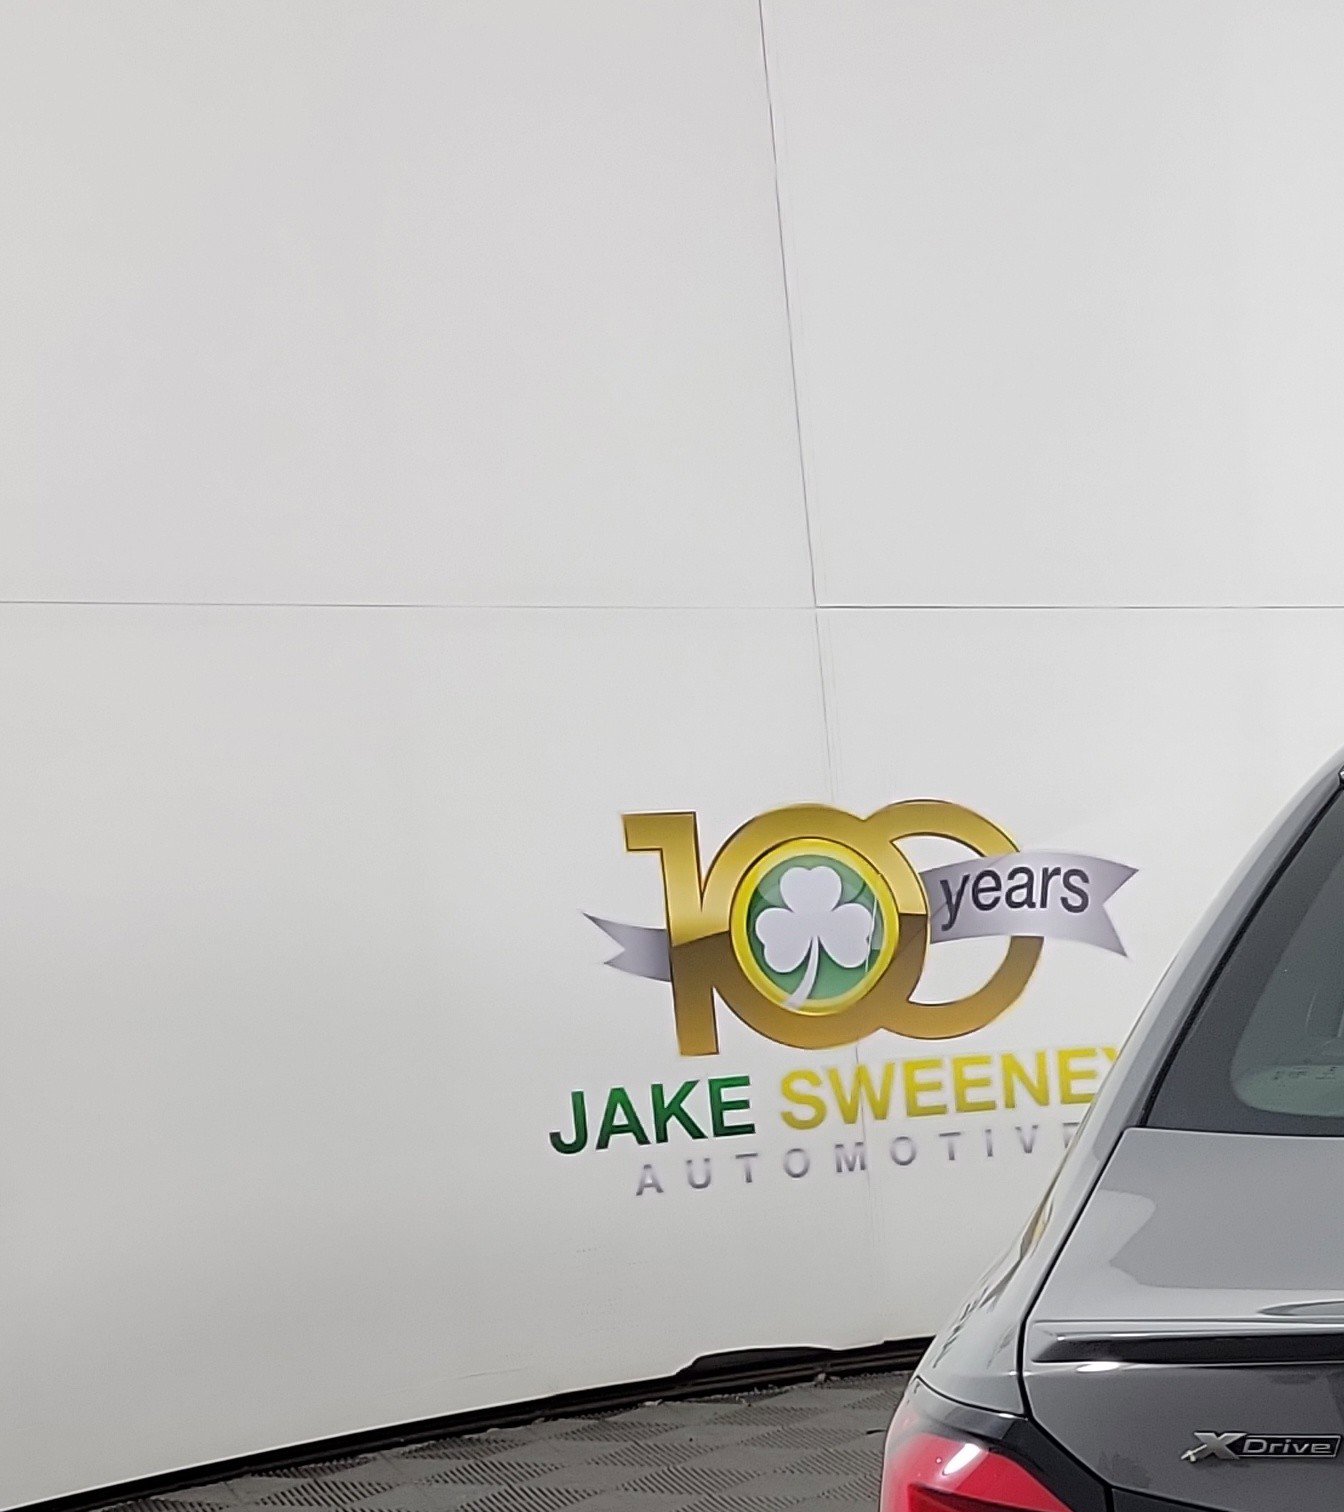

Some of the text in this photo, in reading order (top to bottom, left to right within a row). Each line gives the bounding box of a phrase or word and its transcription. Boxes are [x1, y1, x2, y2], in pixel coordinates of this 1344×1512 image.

[621, 799, 1091, 1056] 100 years
[549, 1075, 756, 1153] JAKE
